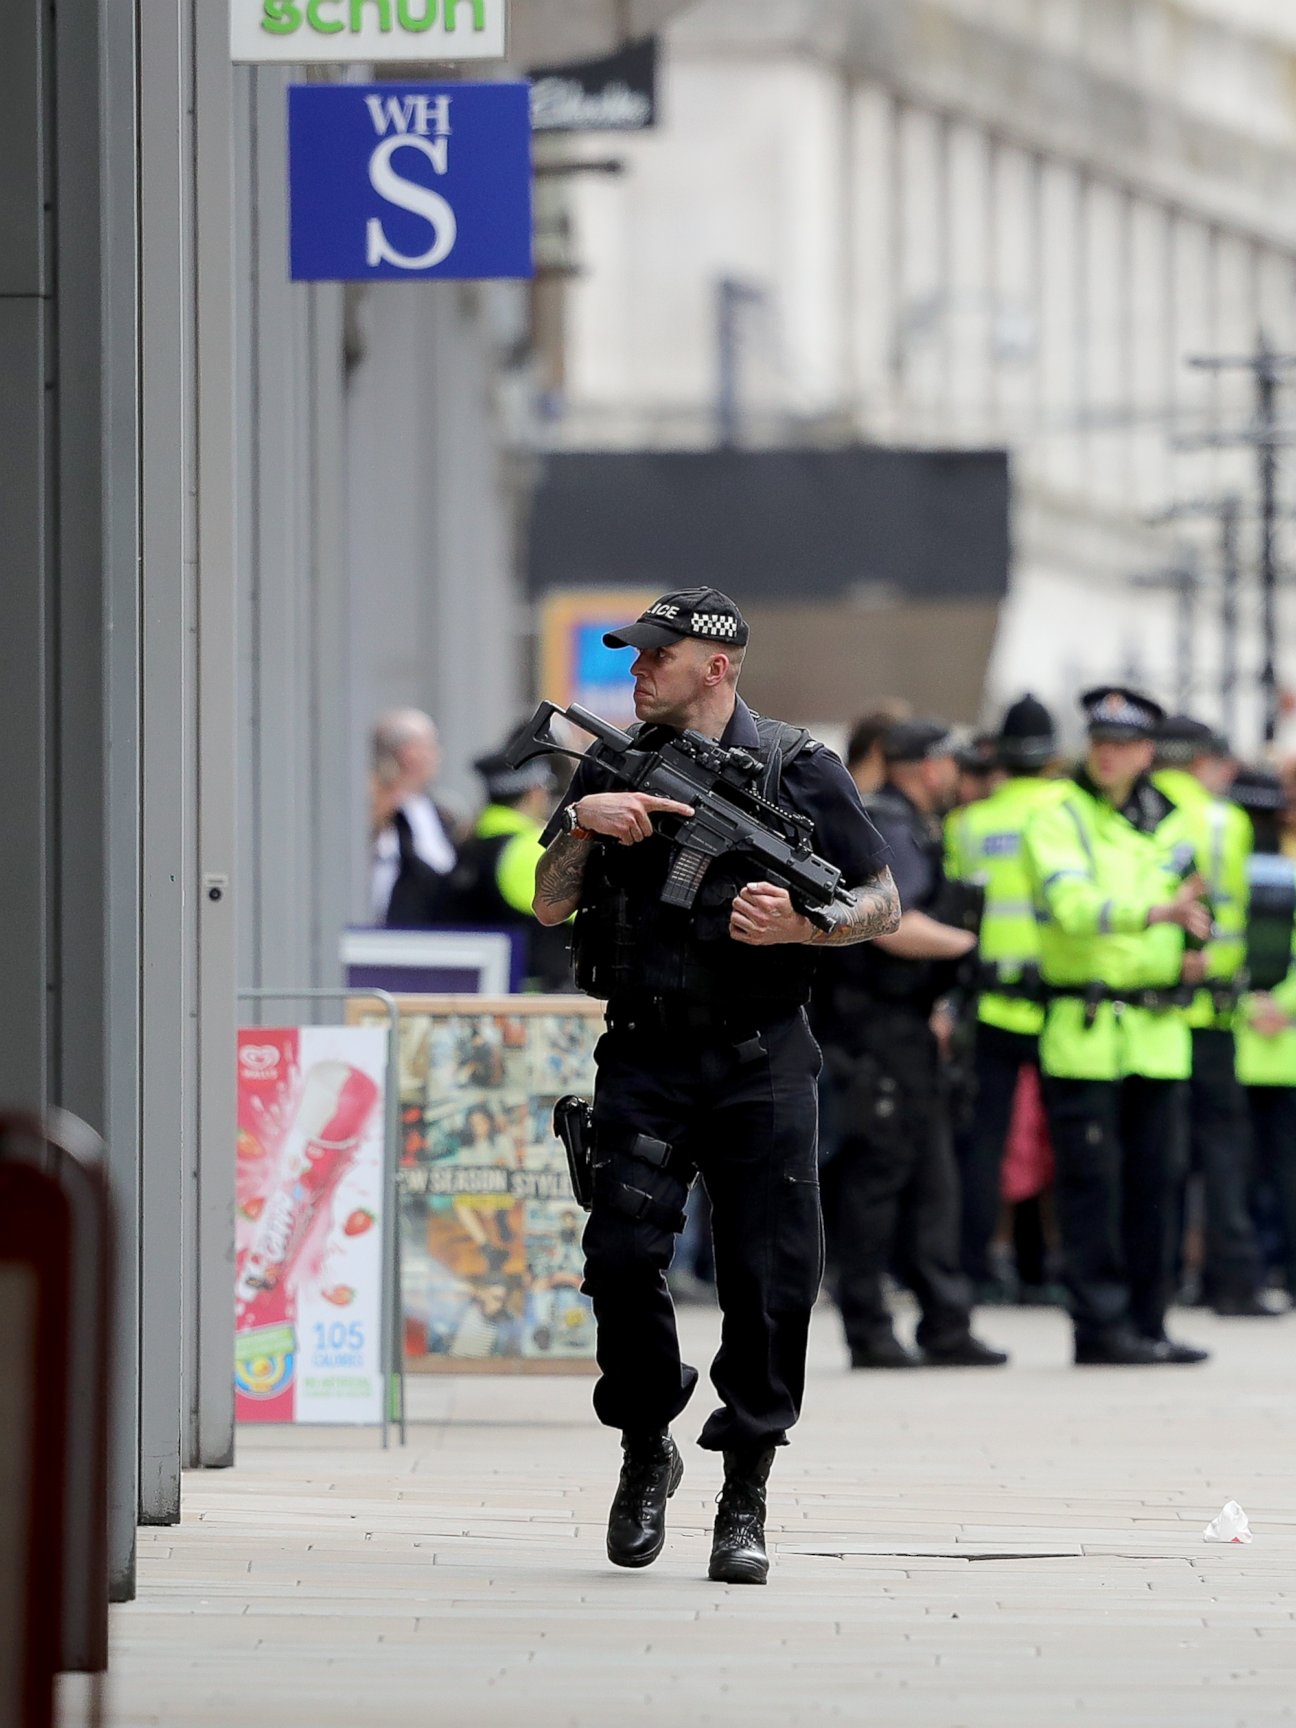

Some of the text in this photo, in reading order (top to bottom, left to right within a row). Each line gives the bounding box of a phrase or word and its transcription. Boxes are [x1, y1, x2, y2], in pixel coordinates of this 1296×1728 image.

[365, 94, 453, 136] WH
[366, 133, 457, 270] S
[313, 1321, 365, 1350] 105
